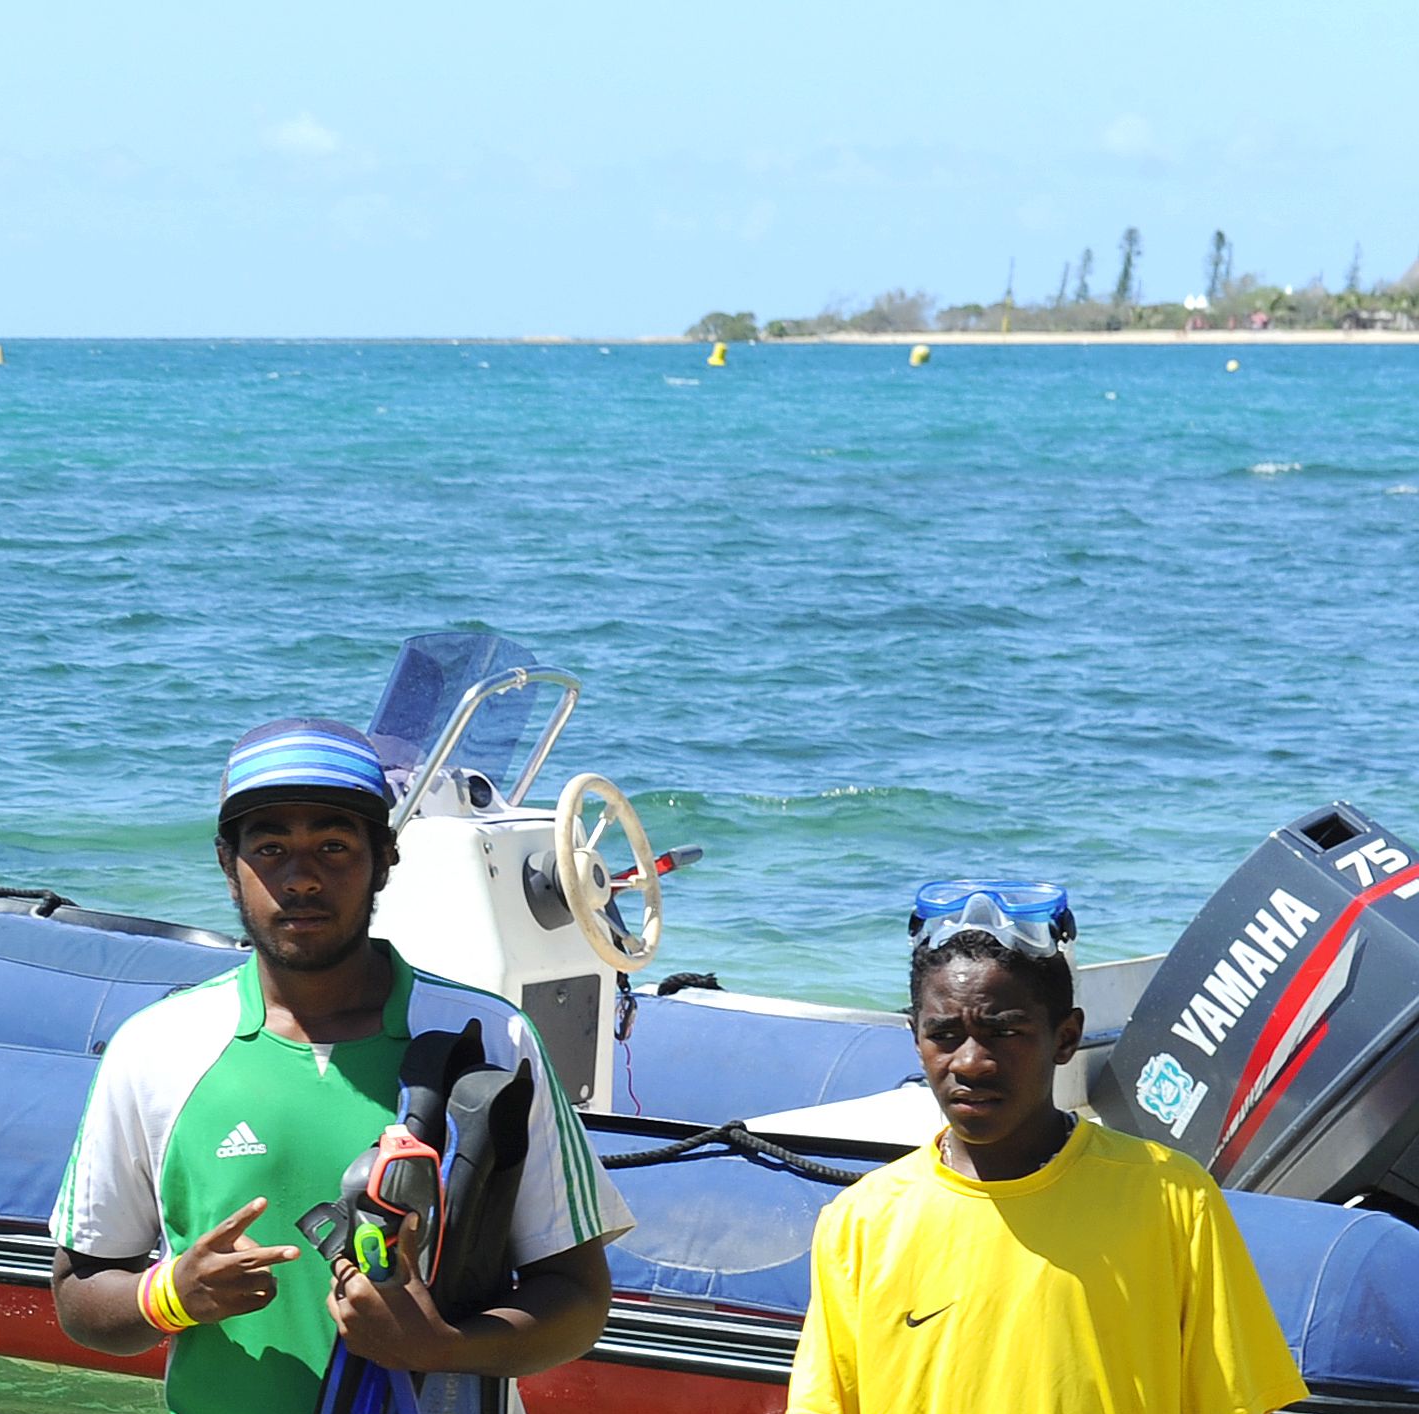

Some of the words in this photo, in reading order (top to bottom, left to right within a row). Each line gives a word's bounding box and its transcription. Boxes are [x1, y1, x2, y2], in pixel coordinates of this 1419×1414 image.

[1335, 838, 1410, 888] 75
[1170, 888, 1321, 1057] YAMAHA
[215, 1142, 267, 1158] adidas
